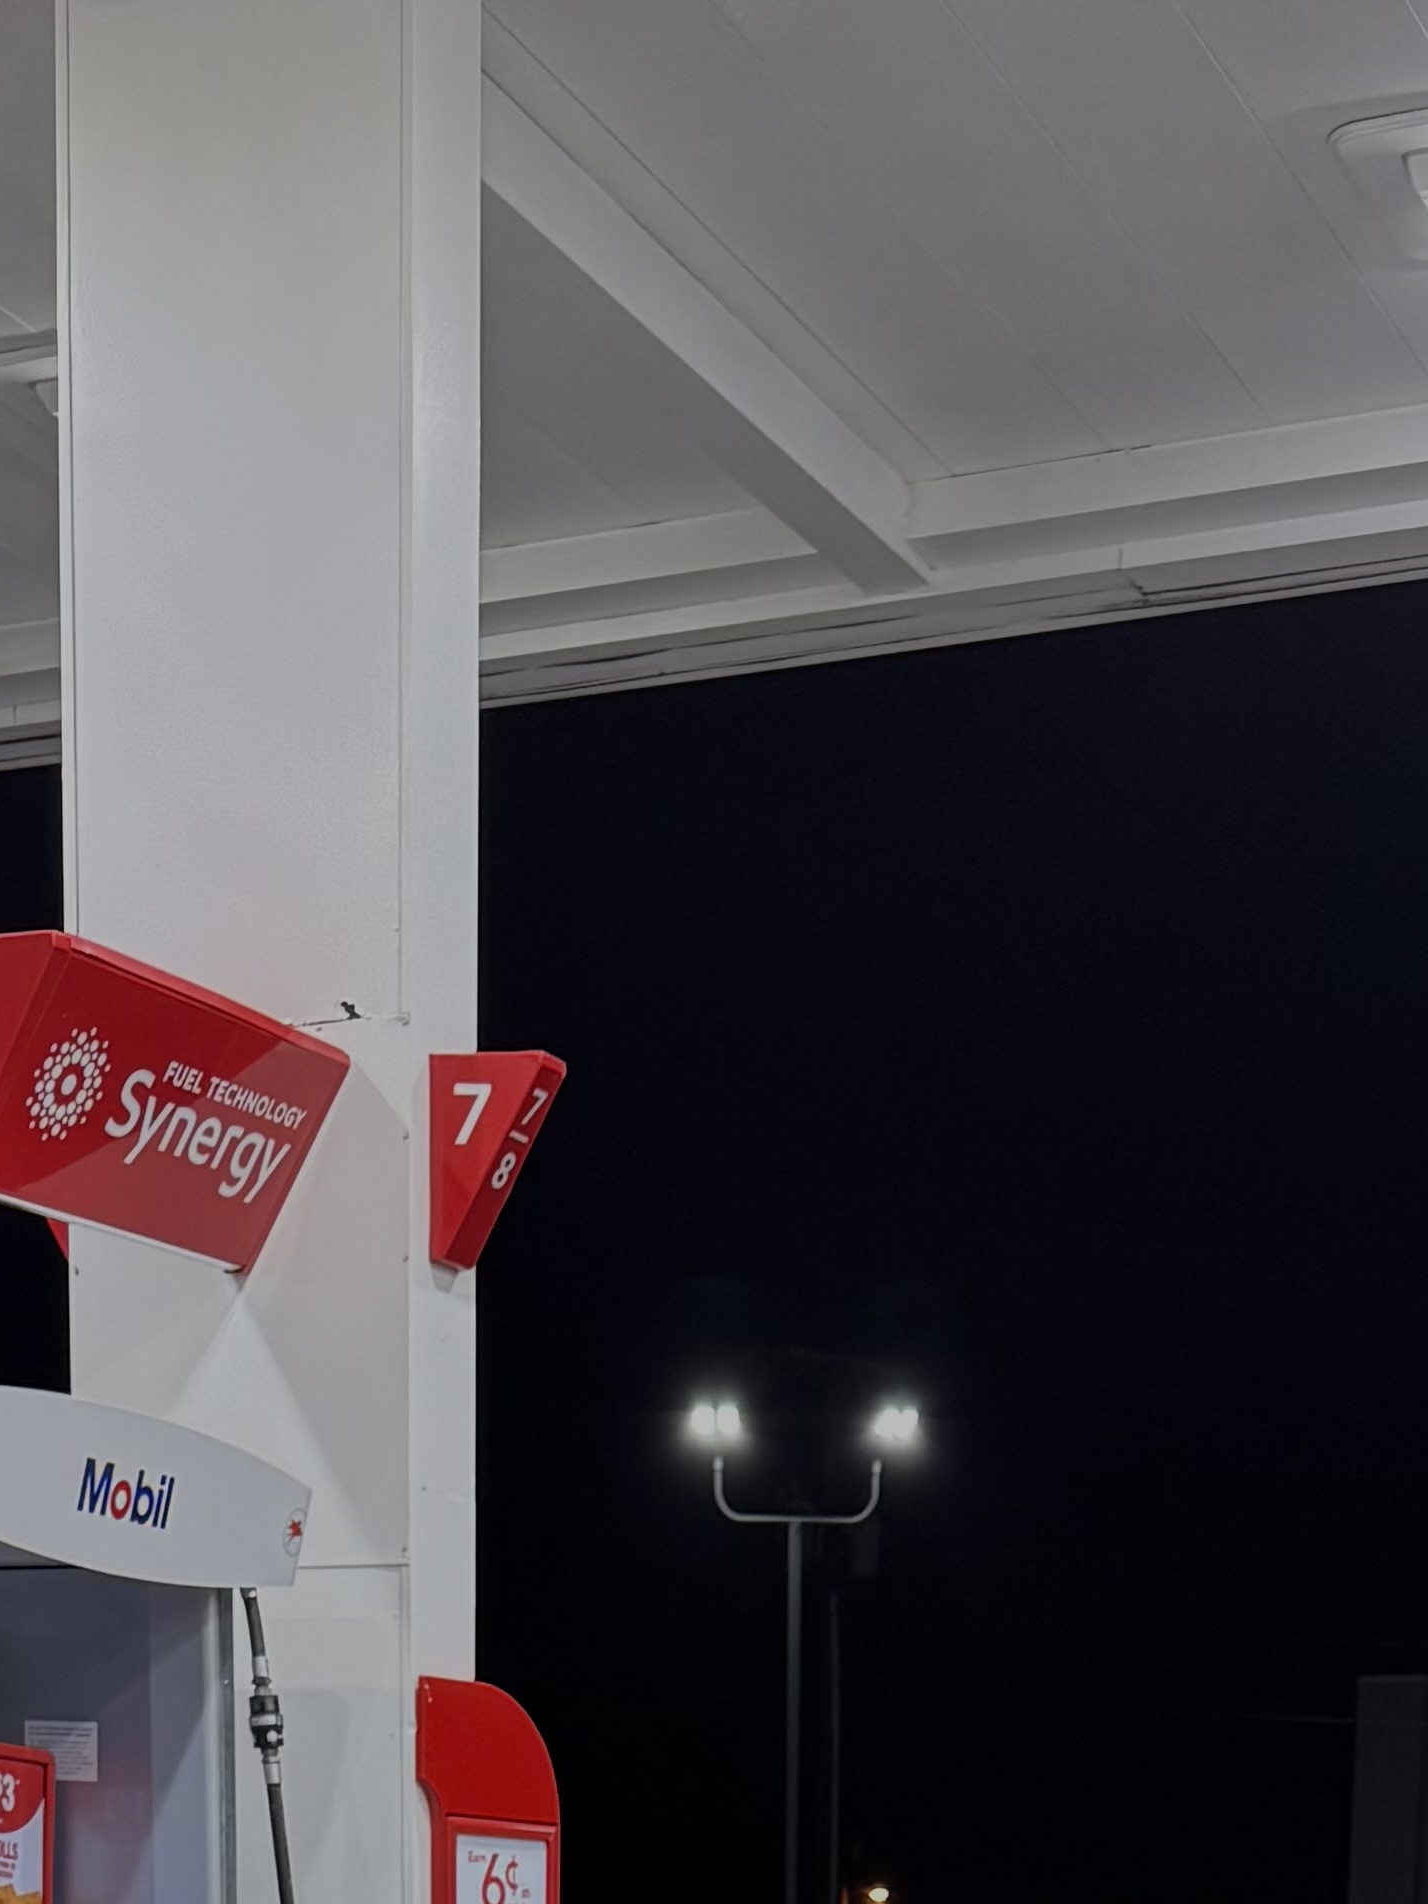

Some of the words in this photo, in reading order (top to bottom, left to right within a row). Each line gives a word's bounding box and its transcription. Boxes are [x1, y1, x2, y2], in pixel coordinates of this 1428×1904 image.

[162, 1061, 204, 1095] FUEL
[206, 1076, 308, 1130] TECHNOLOGY
[453, 1082, 492, 1145] 7
[104, 1069, 292, 1204] Synergy
[77, 1457, 175, 1530] Mobil
